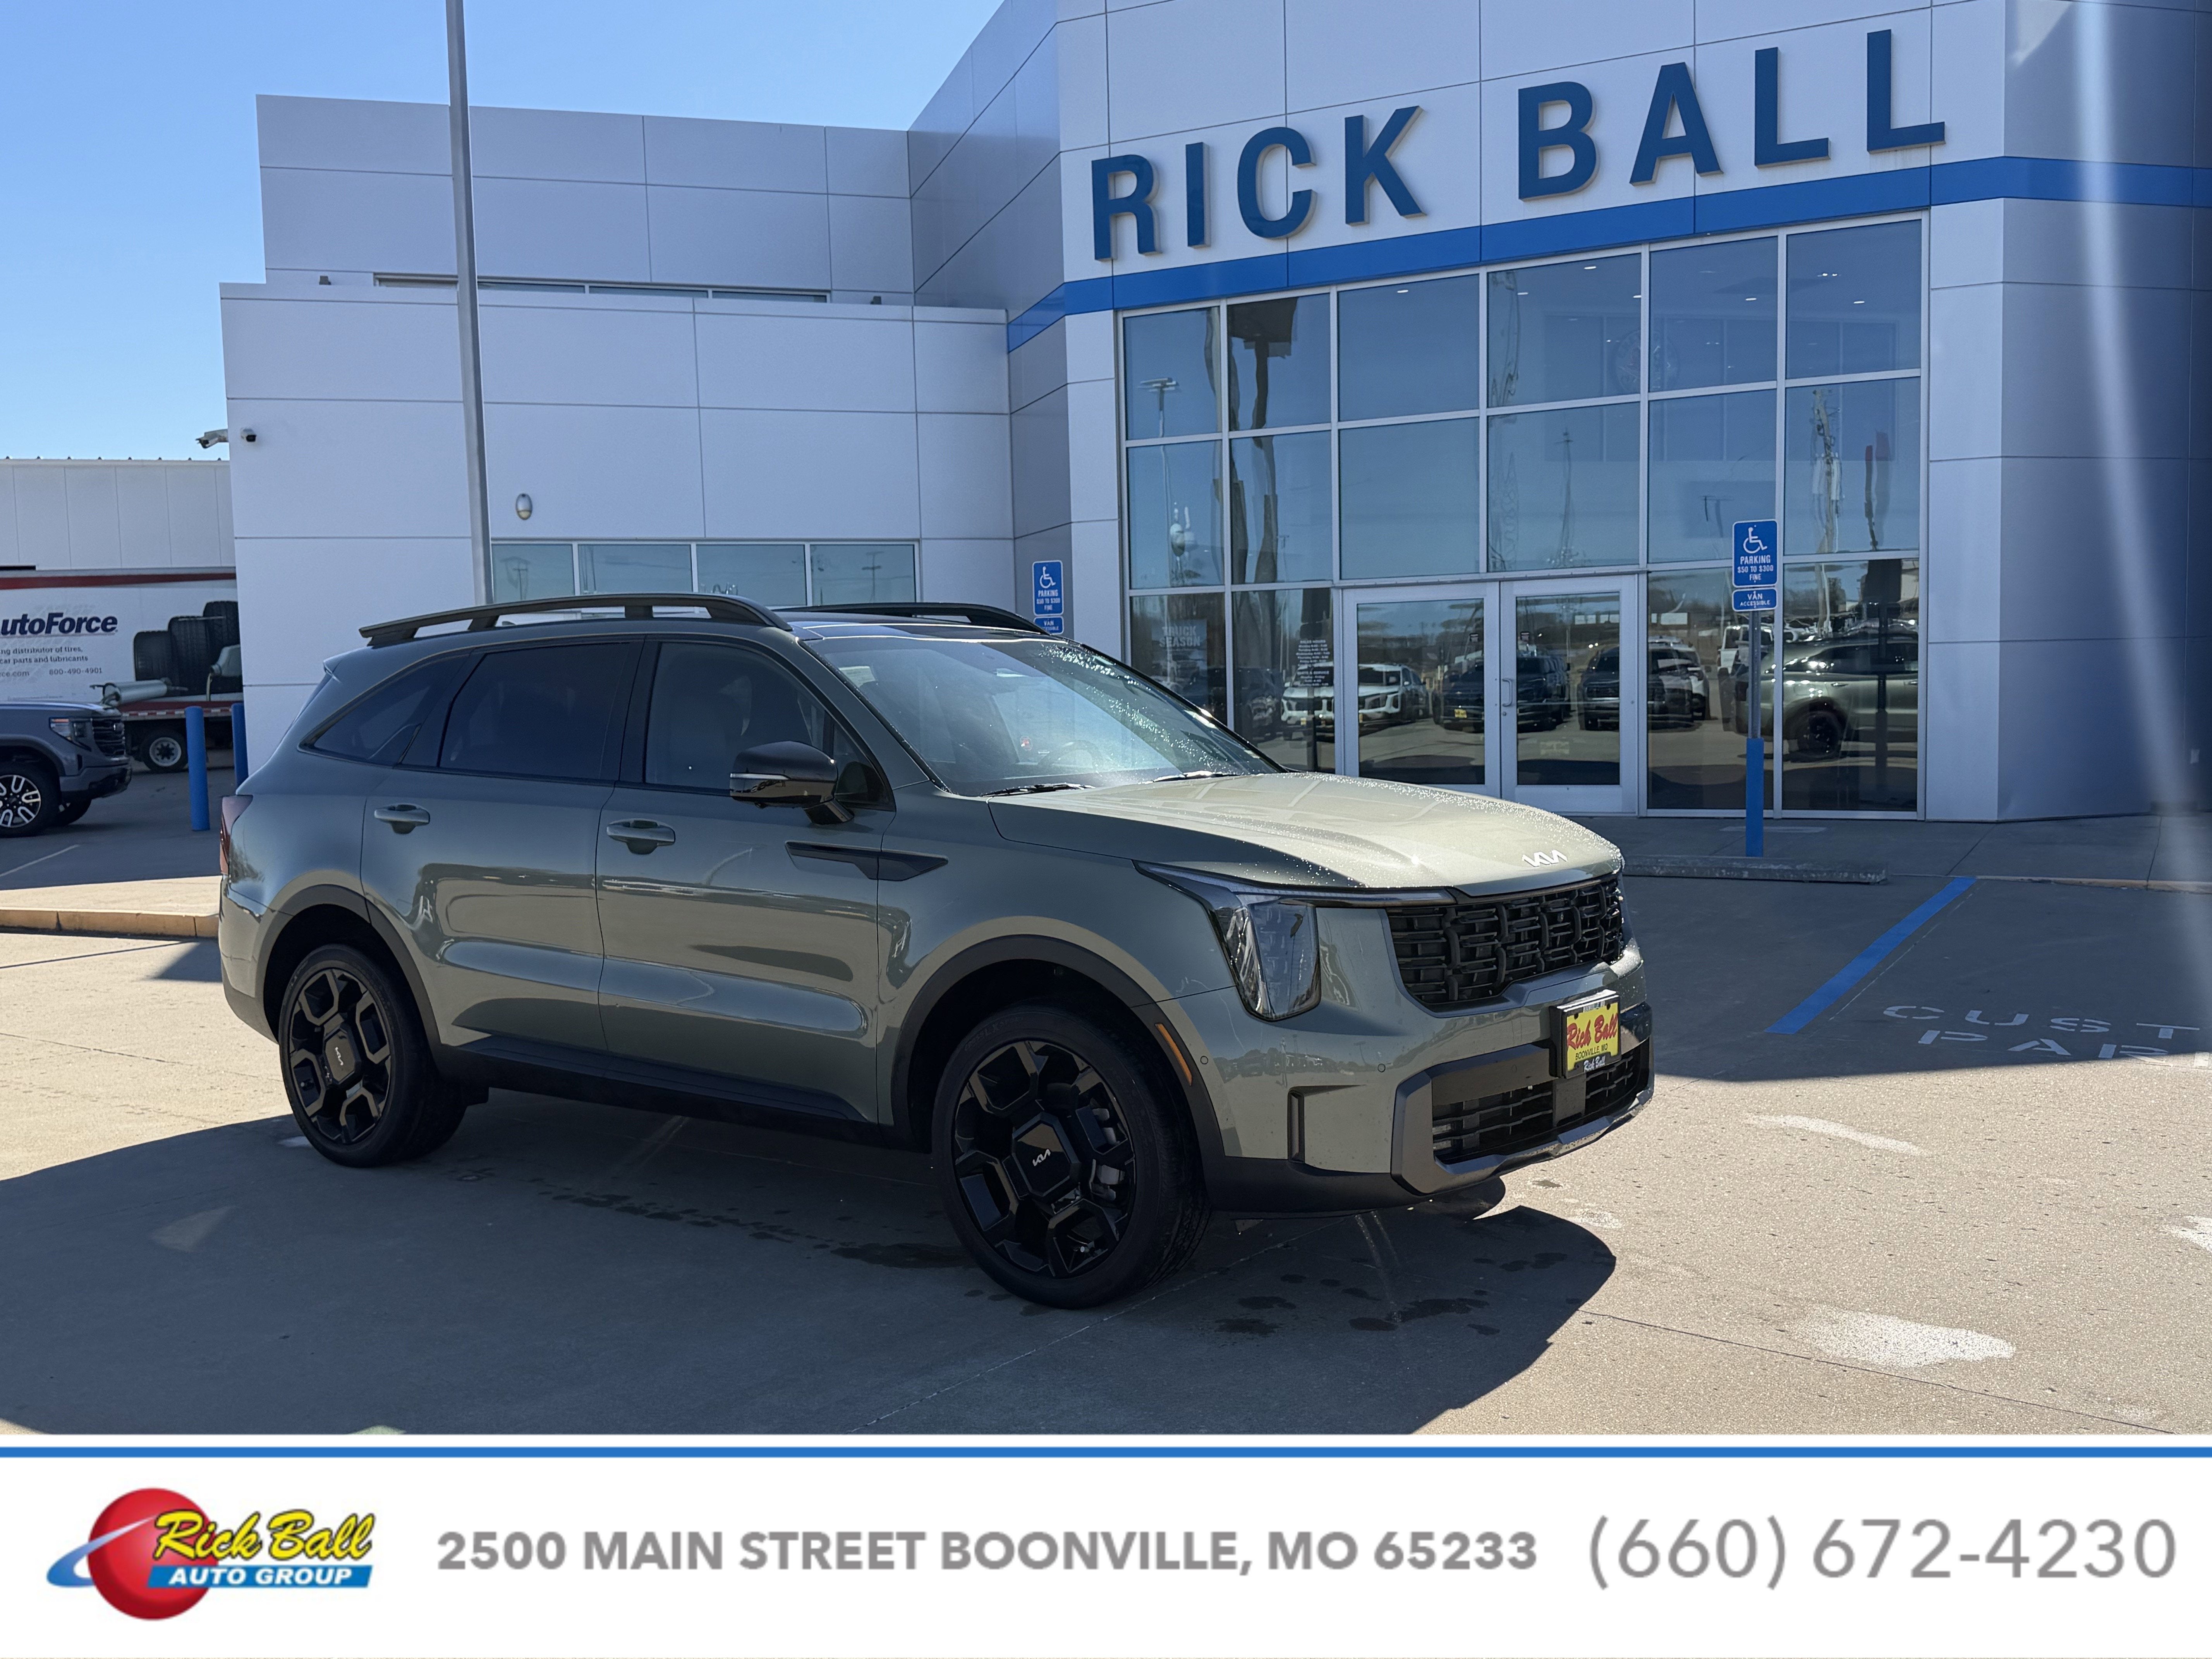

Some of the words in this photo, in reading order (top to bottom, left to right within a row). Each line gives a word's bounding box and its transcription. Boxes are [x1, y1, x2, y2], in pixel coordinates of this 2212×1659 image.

[1091, 105, 1427, 261] RICK
[1518, 29, 1946, 201] BALL
[1740, 555, 1771, 565] PARKING
[0, 612, 118, 635] utoForce
[1162, 625, 1197, 637] TRUCK
[1159, 636, 1200, 647] SEASON
[49, 667, 102, 676] 800-490-4901
[1883, 1005, 2200, 1039] CUST
[1567, 1019, 1592, 1050] Rick
[1594, 1012, 1618, 1043] Ball
[1583, 1058, 1595, 1073] Rick
[1595, 1056, 1606, 1068] Ball
